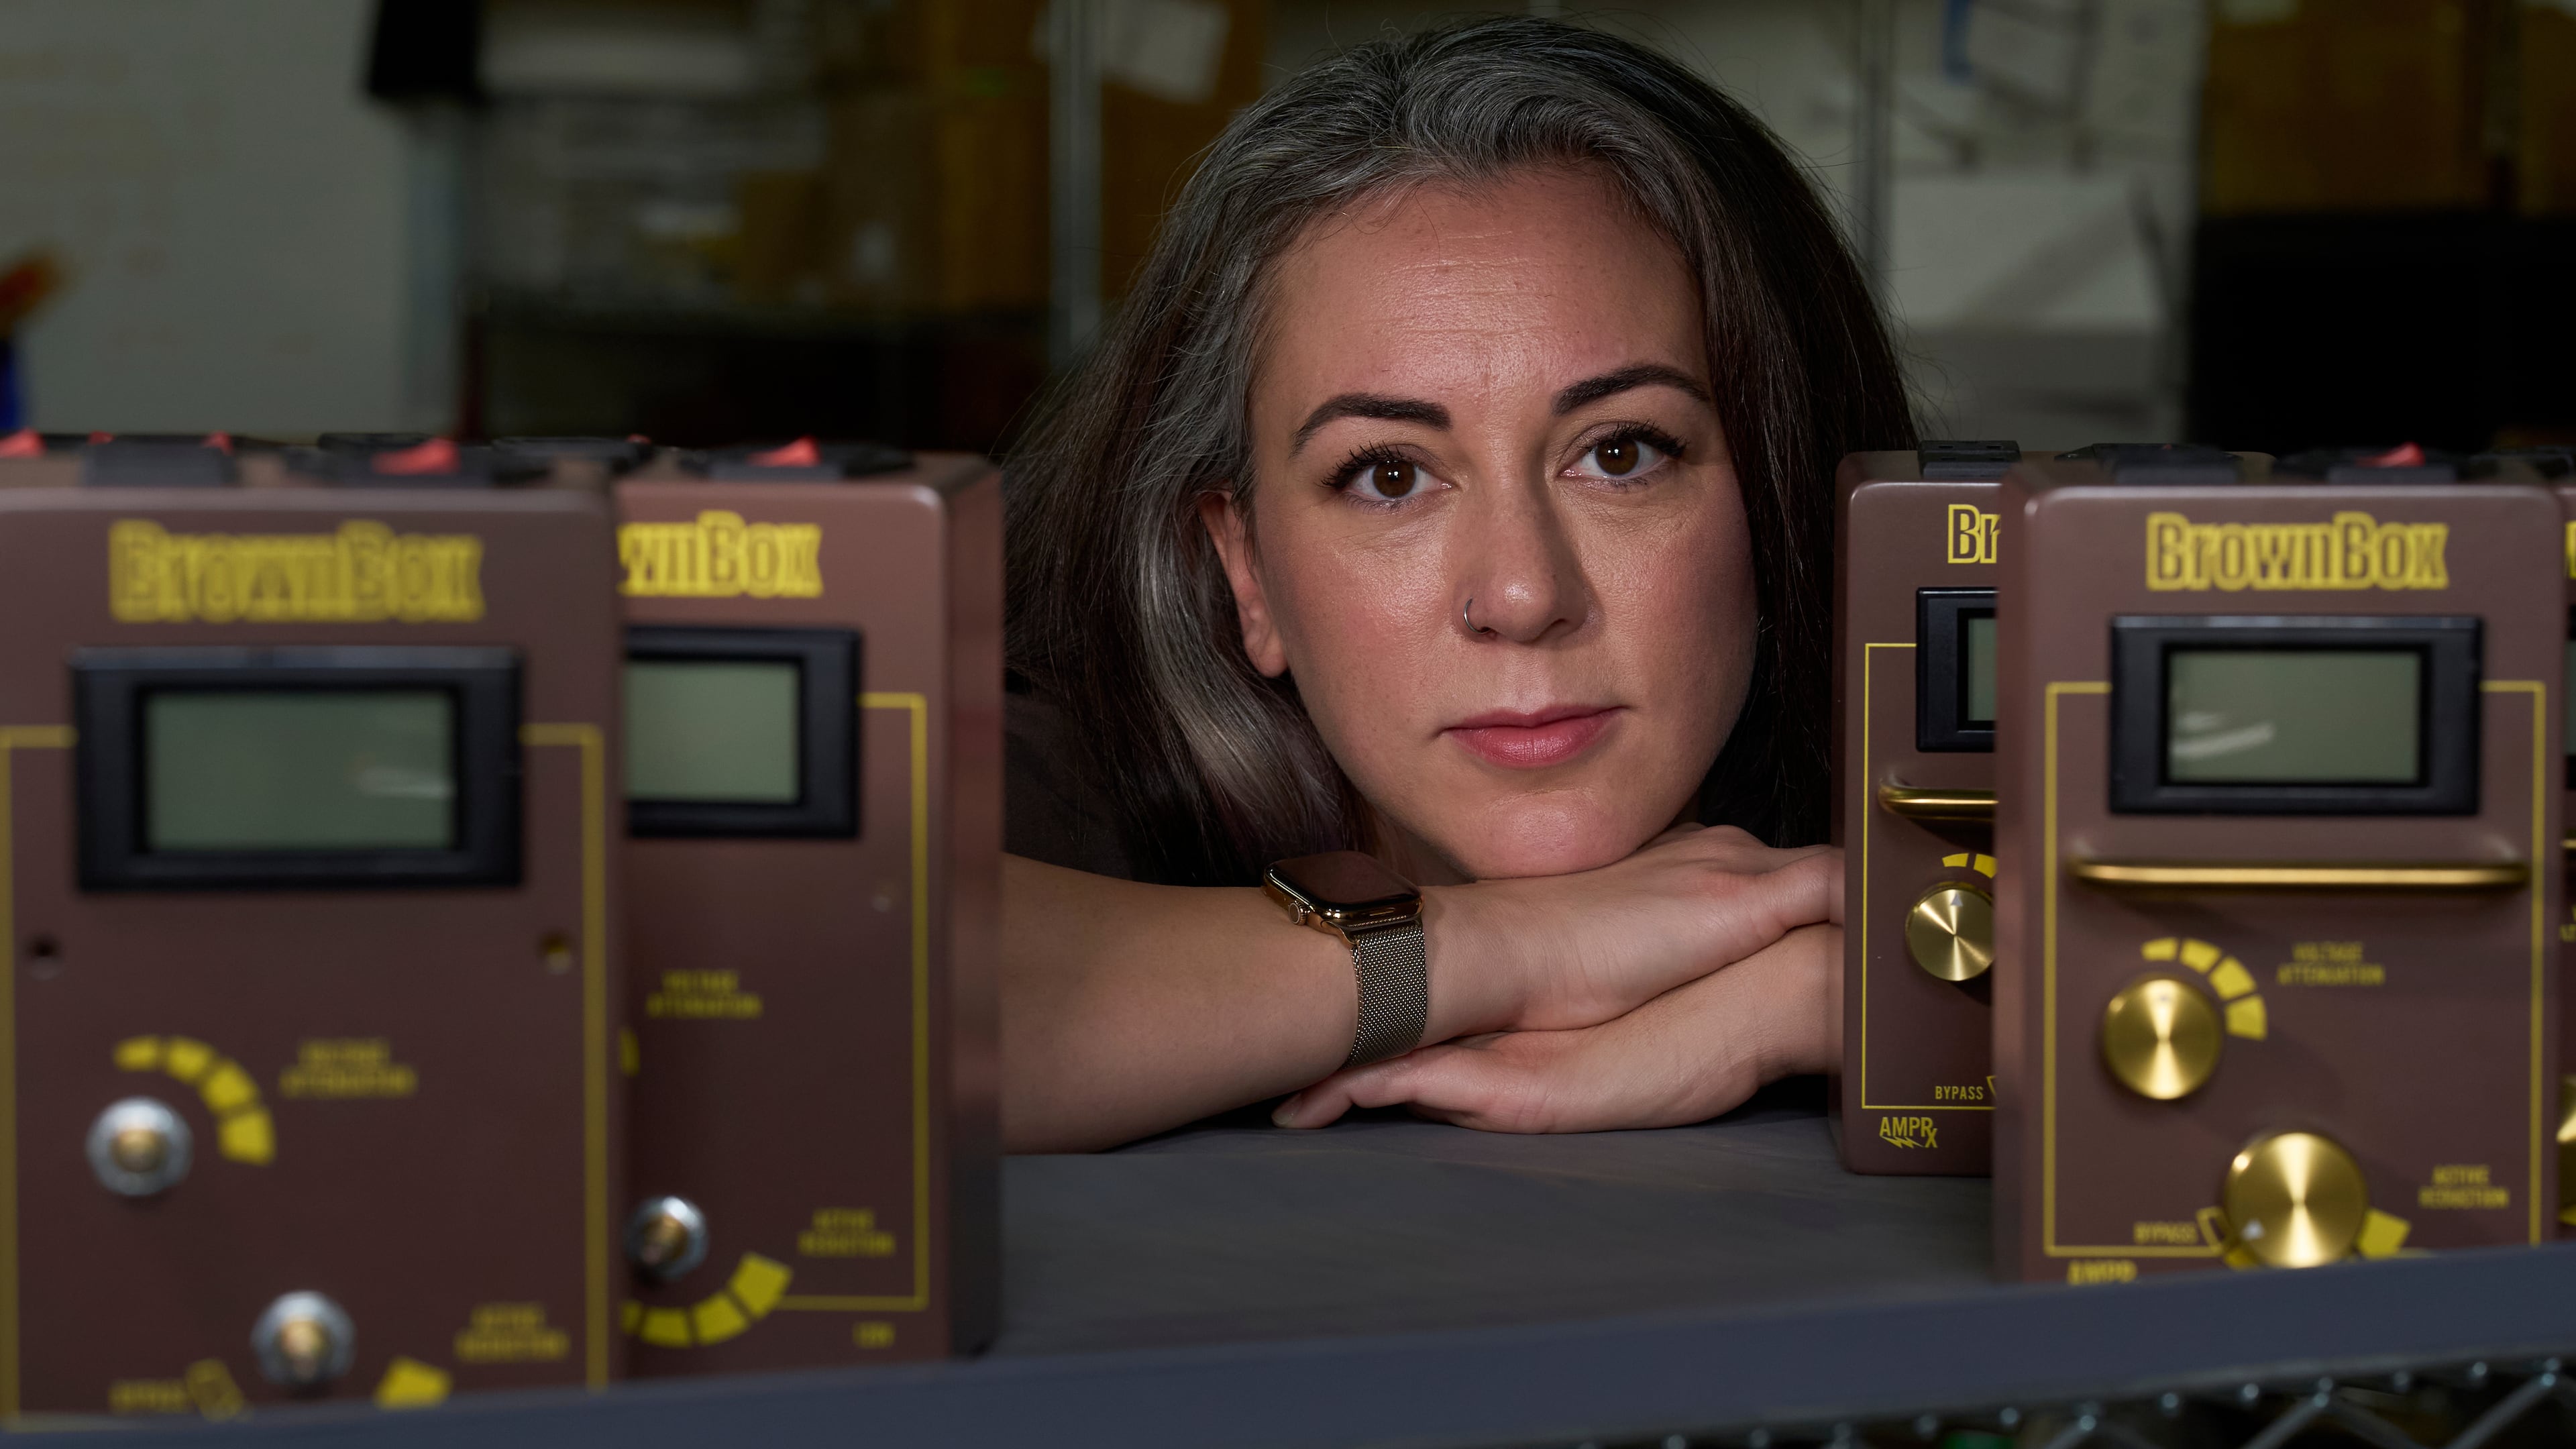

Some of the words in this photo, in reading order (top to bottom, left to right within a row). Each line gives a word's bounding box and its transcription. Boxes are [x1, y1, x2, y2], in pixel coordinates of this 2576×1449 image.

[109, 519, 486, 623] BrownBox
[2147, 511, 2449, 592] BrownBox
[1935, 1085, 1984, 1100] BYPASS
